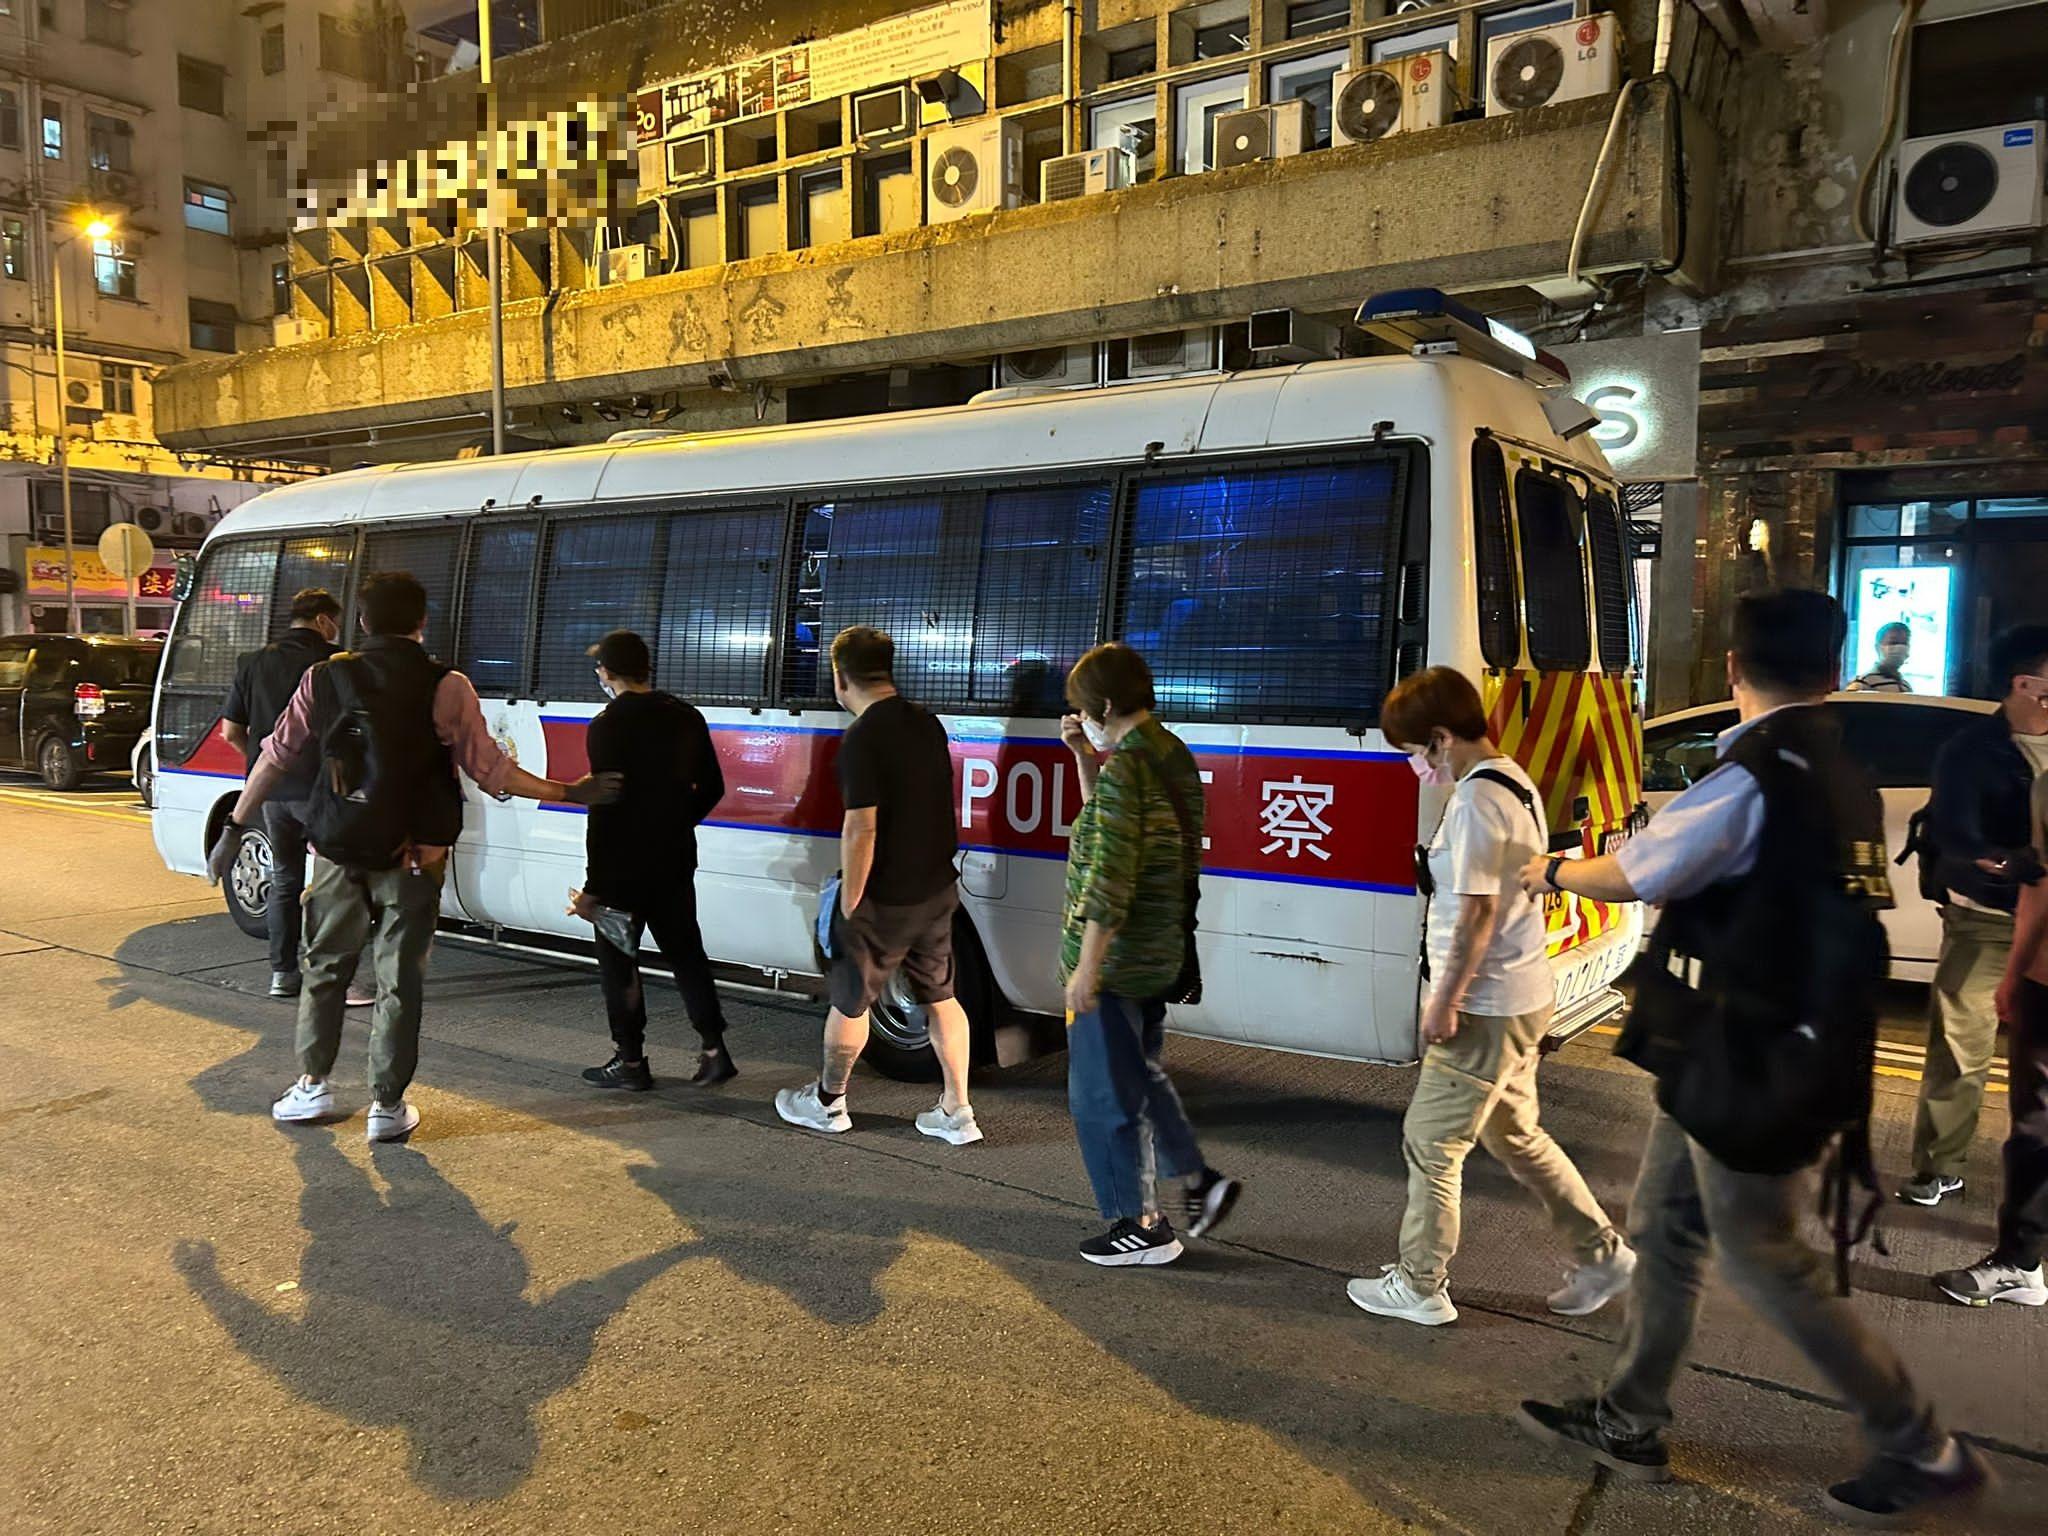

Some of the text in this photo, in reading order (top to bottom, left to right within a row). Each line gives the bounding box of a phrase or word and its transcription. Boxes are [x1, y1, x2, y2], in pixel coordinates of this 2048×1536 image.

[1577, 48, 1598, 62] LG
[1412, 83, 1430, 96] LG
[1585, 385, 1638, 449] S
[961, 758, 1213, 850] POL
[1259, 775, 1334, 861] 察
